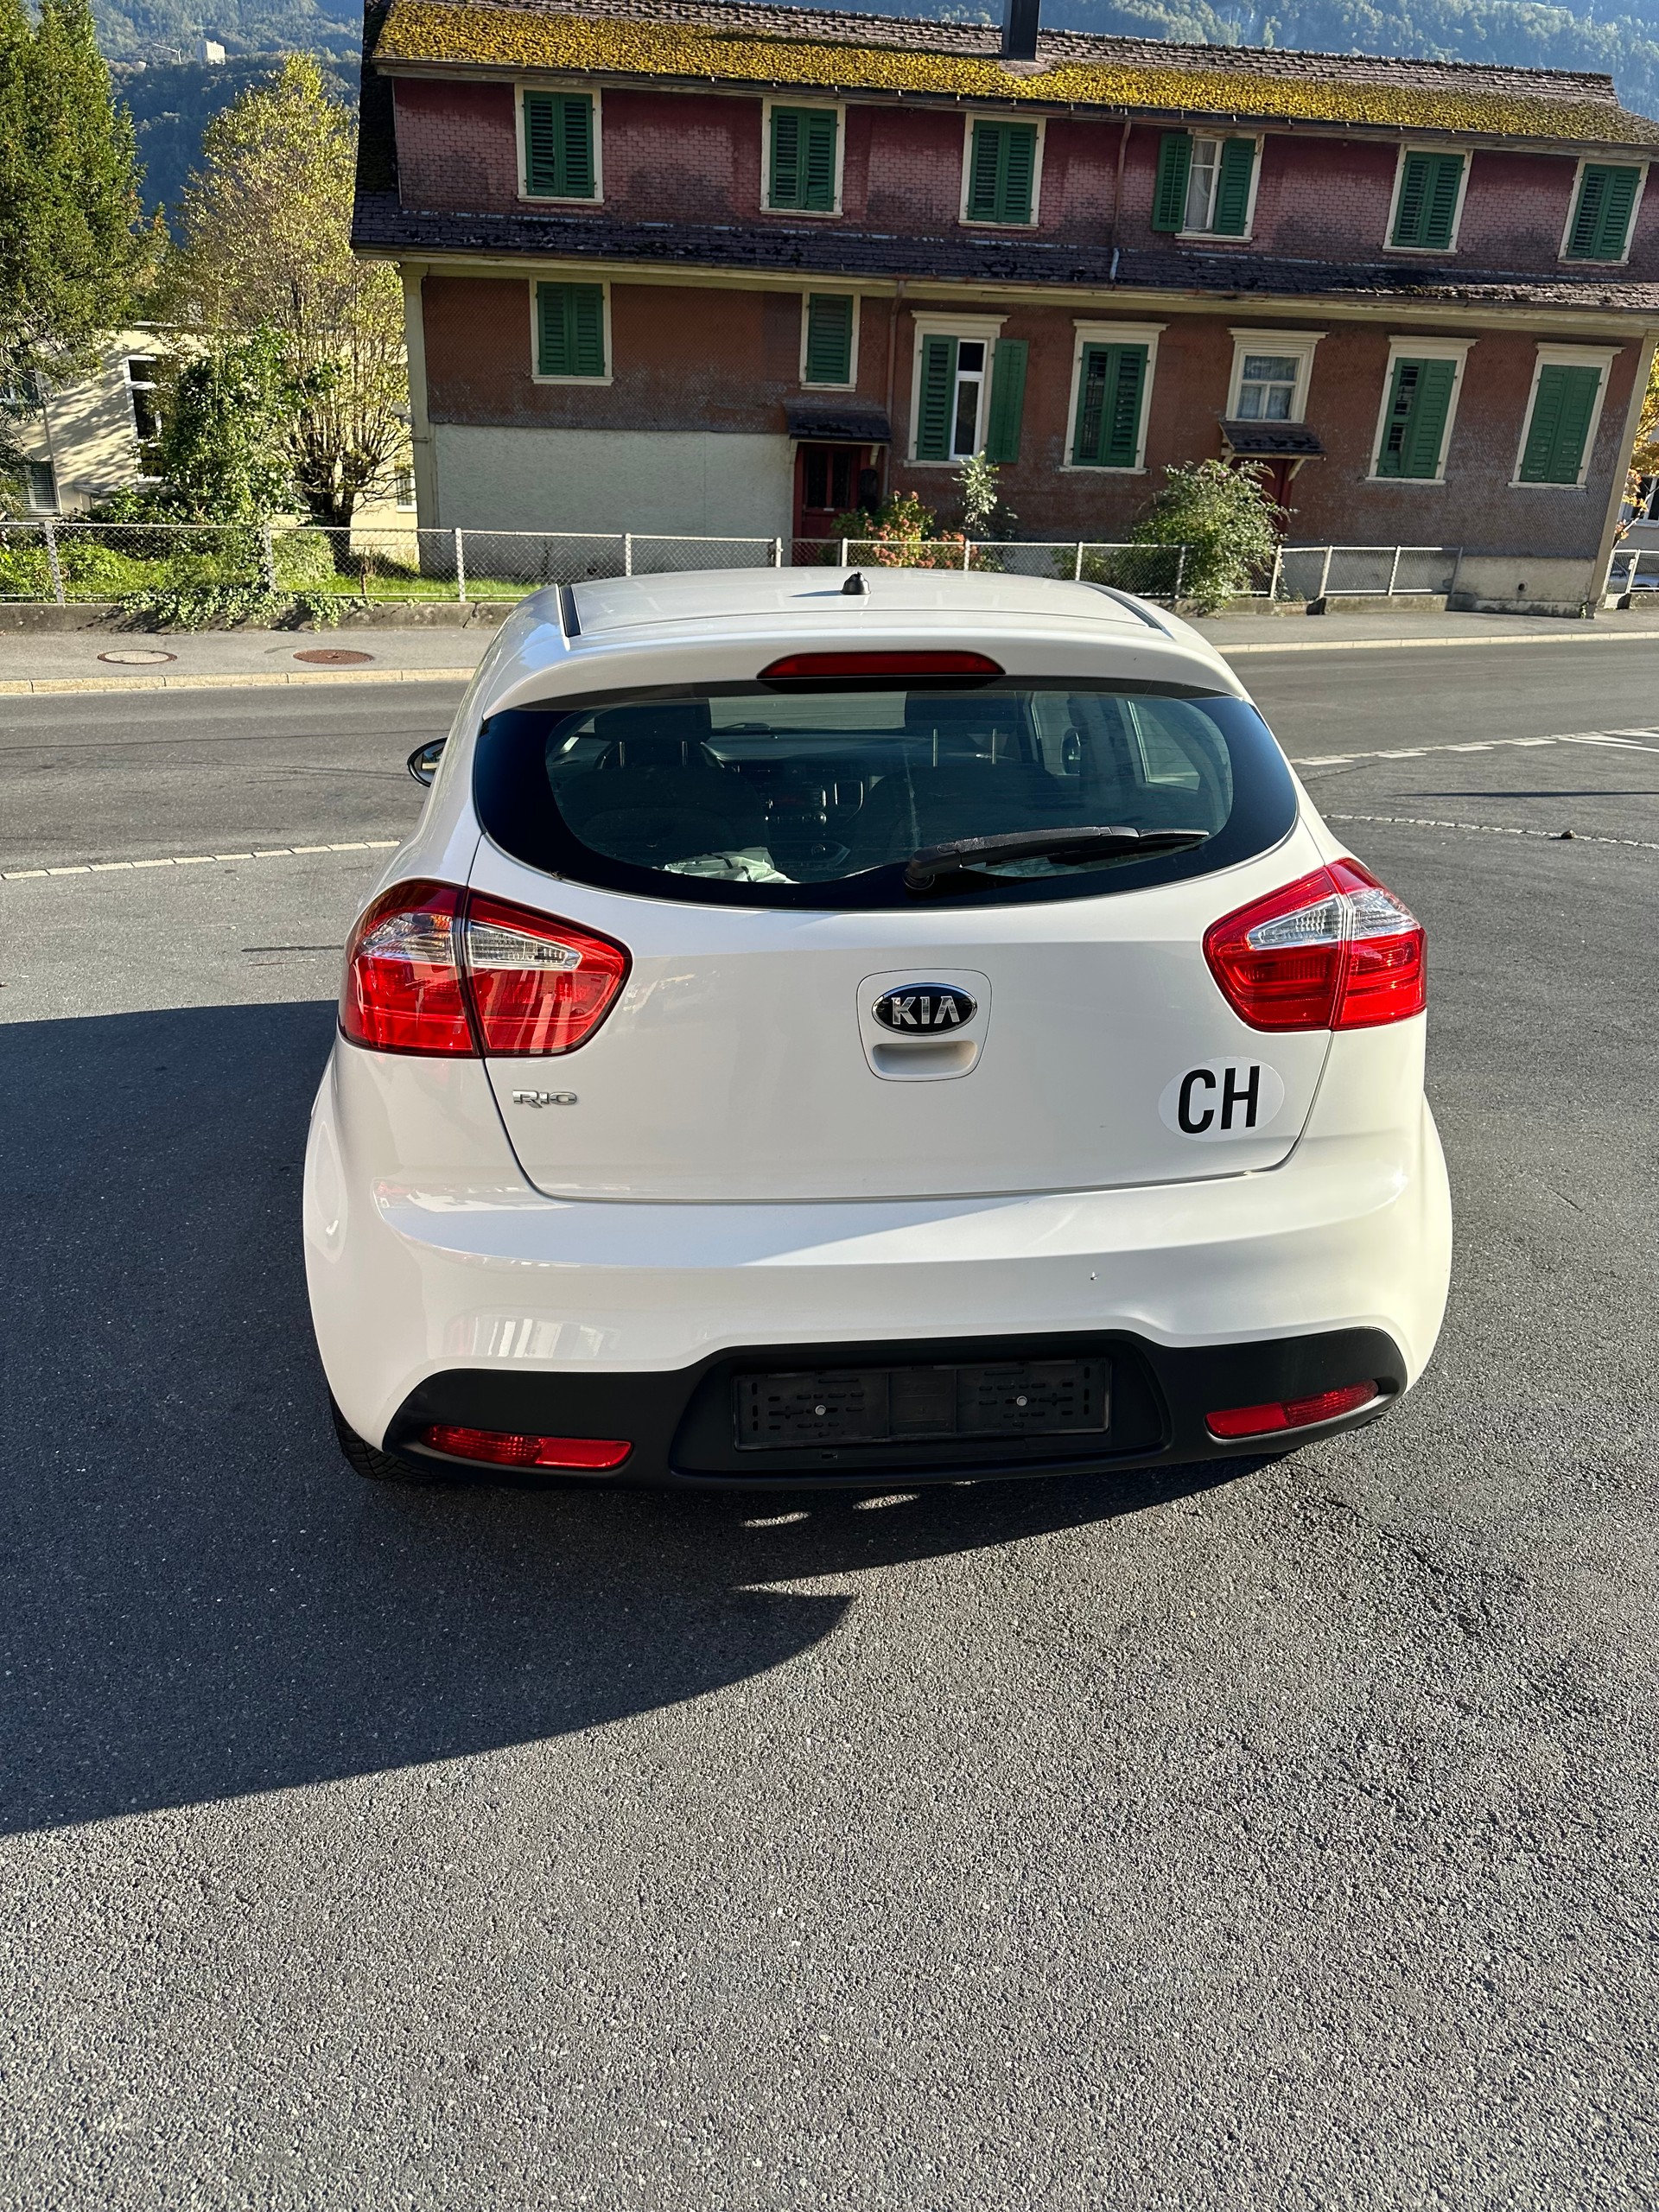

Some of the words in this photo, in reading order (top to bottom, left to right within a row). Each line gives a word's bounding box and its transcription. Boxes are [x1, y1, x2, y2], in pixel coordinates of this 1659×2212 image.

[891, 995, 960, 1025] KIA
[512, 1090, 577, 1108] RIO
[1178, 1065, 1260, 1134] CH
